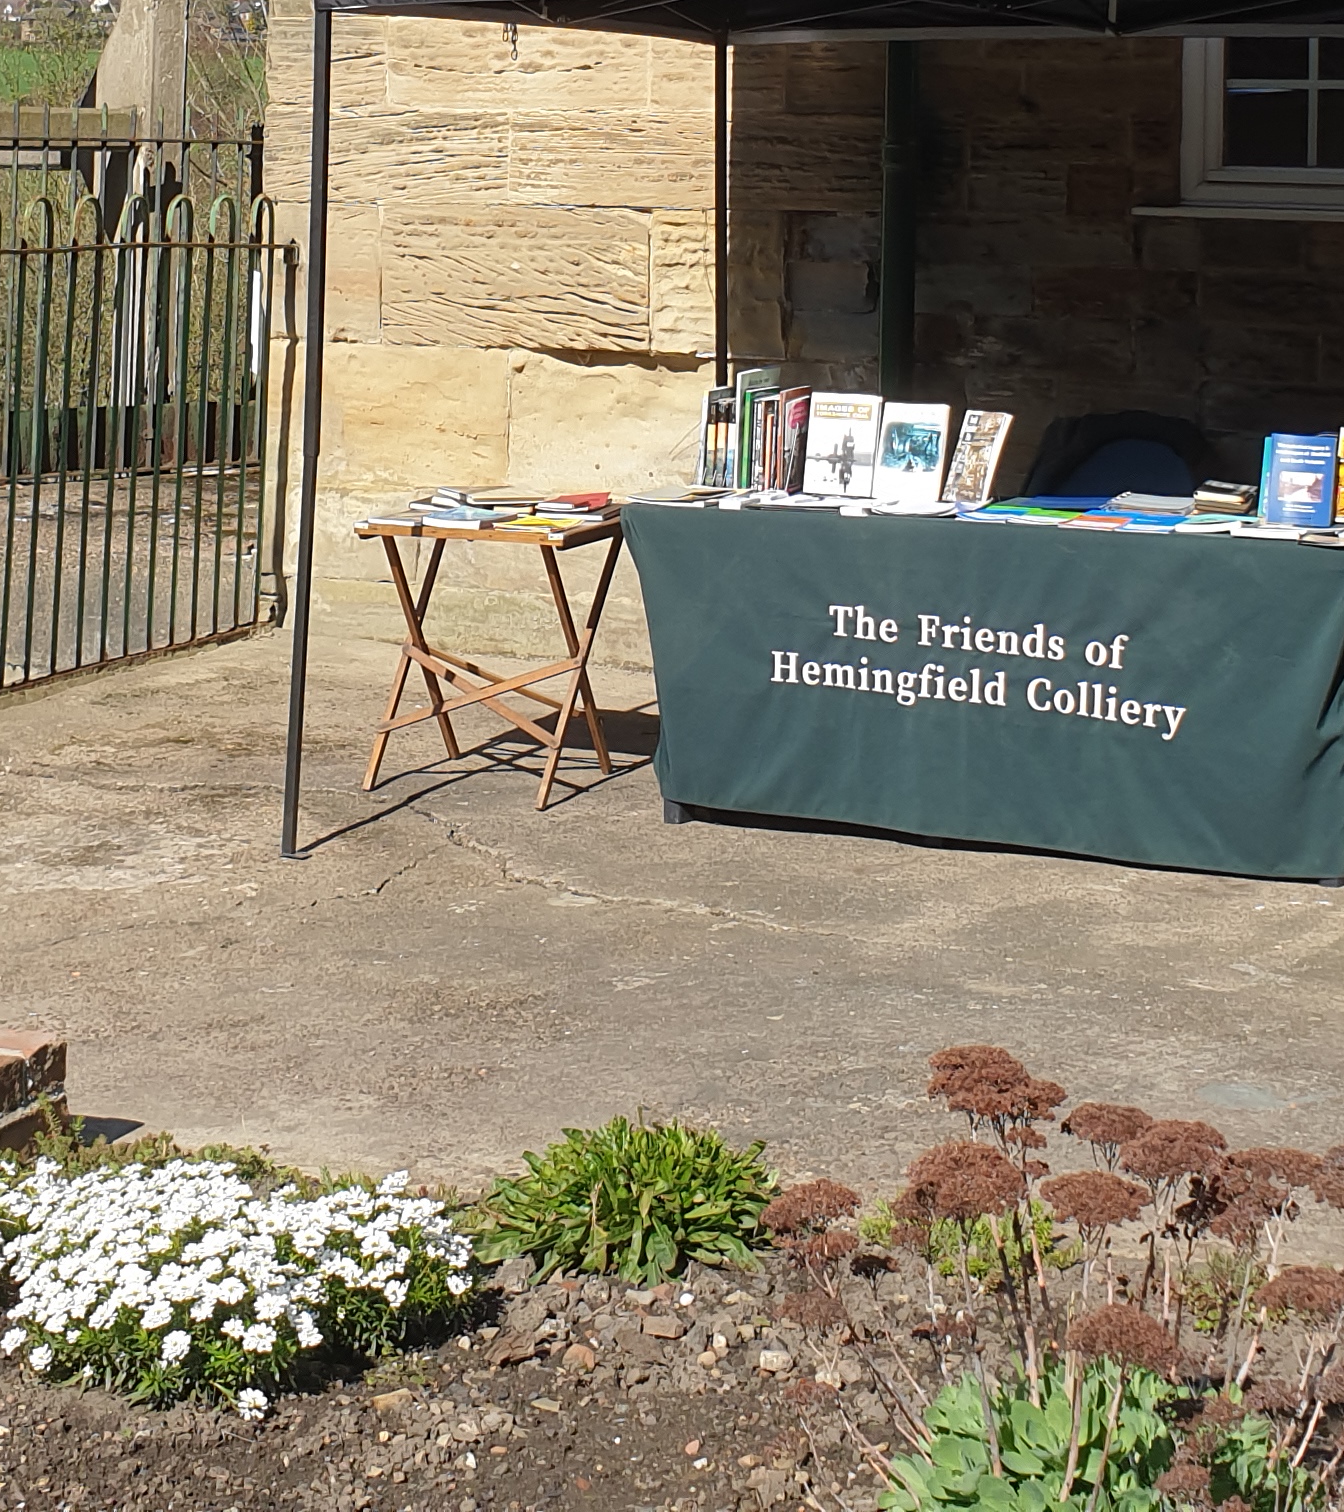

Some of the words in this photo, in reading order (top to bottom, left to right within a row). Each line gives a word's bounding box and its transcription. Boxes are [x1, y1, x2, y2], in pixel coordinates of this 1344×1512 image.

[828, 604, 898, 643] The
[917, 614, 1065, 661] Friends
[1084, 634, 1130, 670] of
[770, 650, 1007, 707] Hemingfield
[1026, 677, 1187, 741] Colliery
